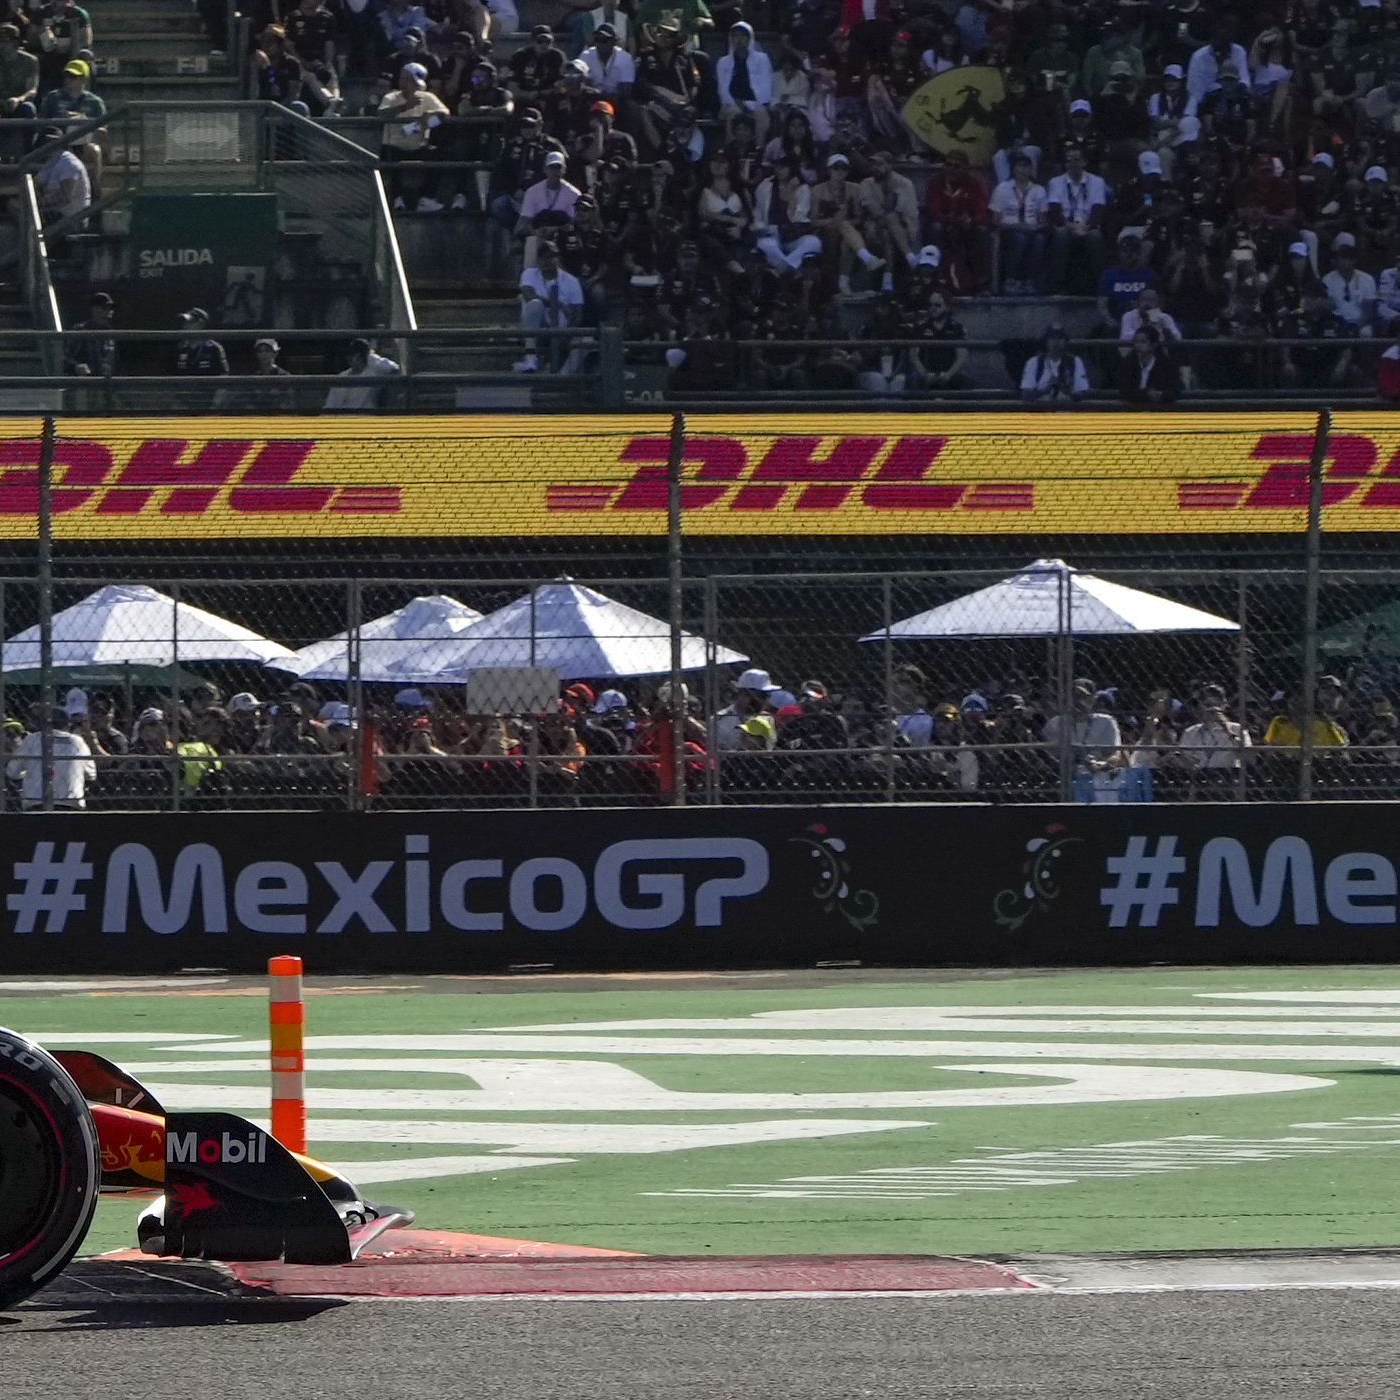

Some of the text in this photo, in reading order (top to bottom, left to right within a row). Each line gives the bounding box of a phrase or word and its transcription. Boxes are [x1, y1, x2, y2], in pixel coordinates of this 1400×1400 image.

[110, 146, 141, 163] F6
[139, 247, 214, 268] SALIDA
[613, 436, 970, 510] DHL
[6, 834, 770, 935] #MexicoGP
[166, 1131, 267, 1164] Mobil
